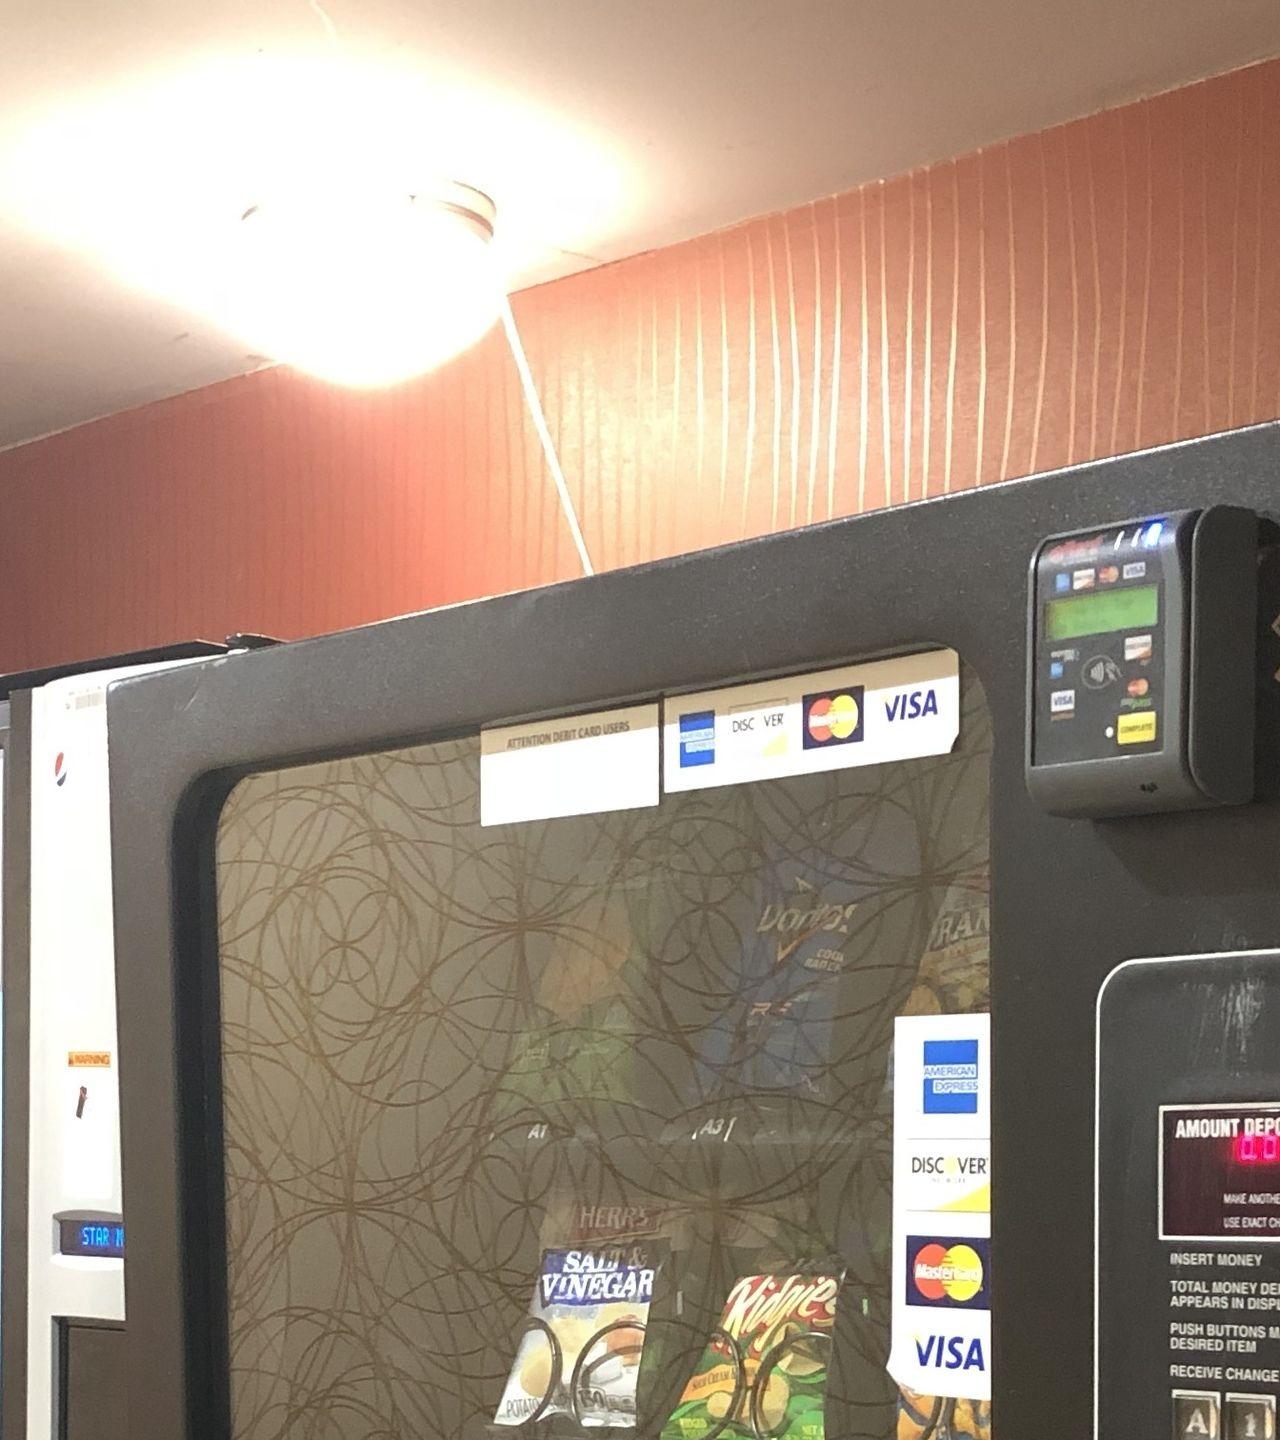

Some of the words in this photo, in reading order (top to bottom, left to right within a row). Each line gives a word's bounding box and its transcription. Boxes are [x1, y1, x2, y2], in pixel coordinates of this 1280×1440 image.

[885, 689, 939, 722] VISA
[732, 713, 784, 733] DISCVER
[507, 734, 551, 749] ATTENTION
[553, 729, 577, 744] DEBIT
[578, 725, 601, 739] CARD
[603, 721, 630, 735] USERS
[924, 1065, 977, 1077] AMERICAN
[935, 1081, 979, 1092] EXPRESS
[1175, 1118, 1240, 1138] AMOUNT
[1224, 1192, 1246, 1205] MAKE
[1223, 1216, 1241, 1229] USE
[1242, 1216, 1267, 1229] EXACT
[82, 1226, 110, 1246] STAR
[563, 1250, 624, 1275] SALT
[1170, 1253, 1214, 1266] INSERT
[1217, 1254, 1262, 1267] MONEY
[542, 1269, 655, 1300] VINEGAR
[1170, 1280, 1209, 1294] TOTAL
[1212, 1281, 1258, 1295] MONEY
[1170, 1295, 1228, 1309] APPEARS
[1231, 1297, 1245, 1309] IN
[1170, 1322, 1204, 1336] PUSH
[1207, 1324, 1266, 1339] BUTTONS
[916, 1335, 986, 1371] VISA
[1170, 1337, 1223, 1352] DESIRED
[1226, 1339, 1257, 1353] ITEM
[1170, 1364, 1222, 1379] RECEIVE
[1225, 1367, 1280, 1383] CHANGE
[1186, 1408, 1208, 1434] A
[1245, 1413, 1256, 1437] 1
